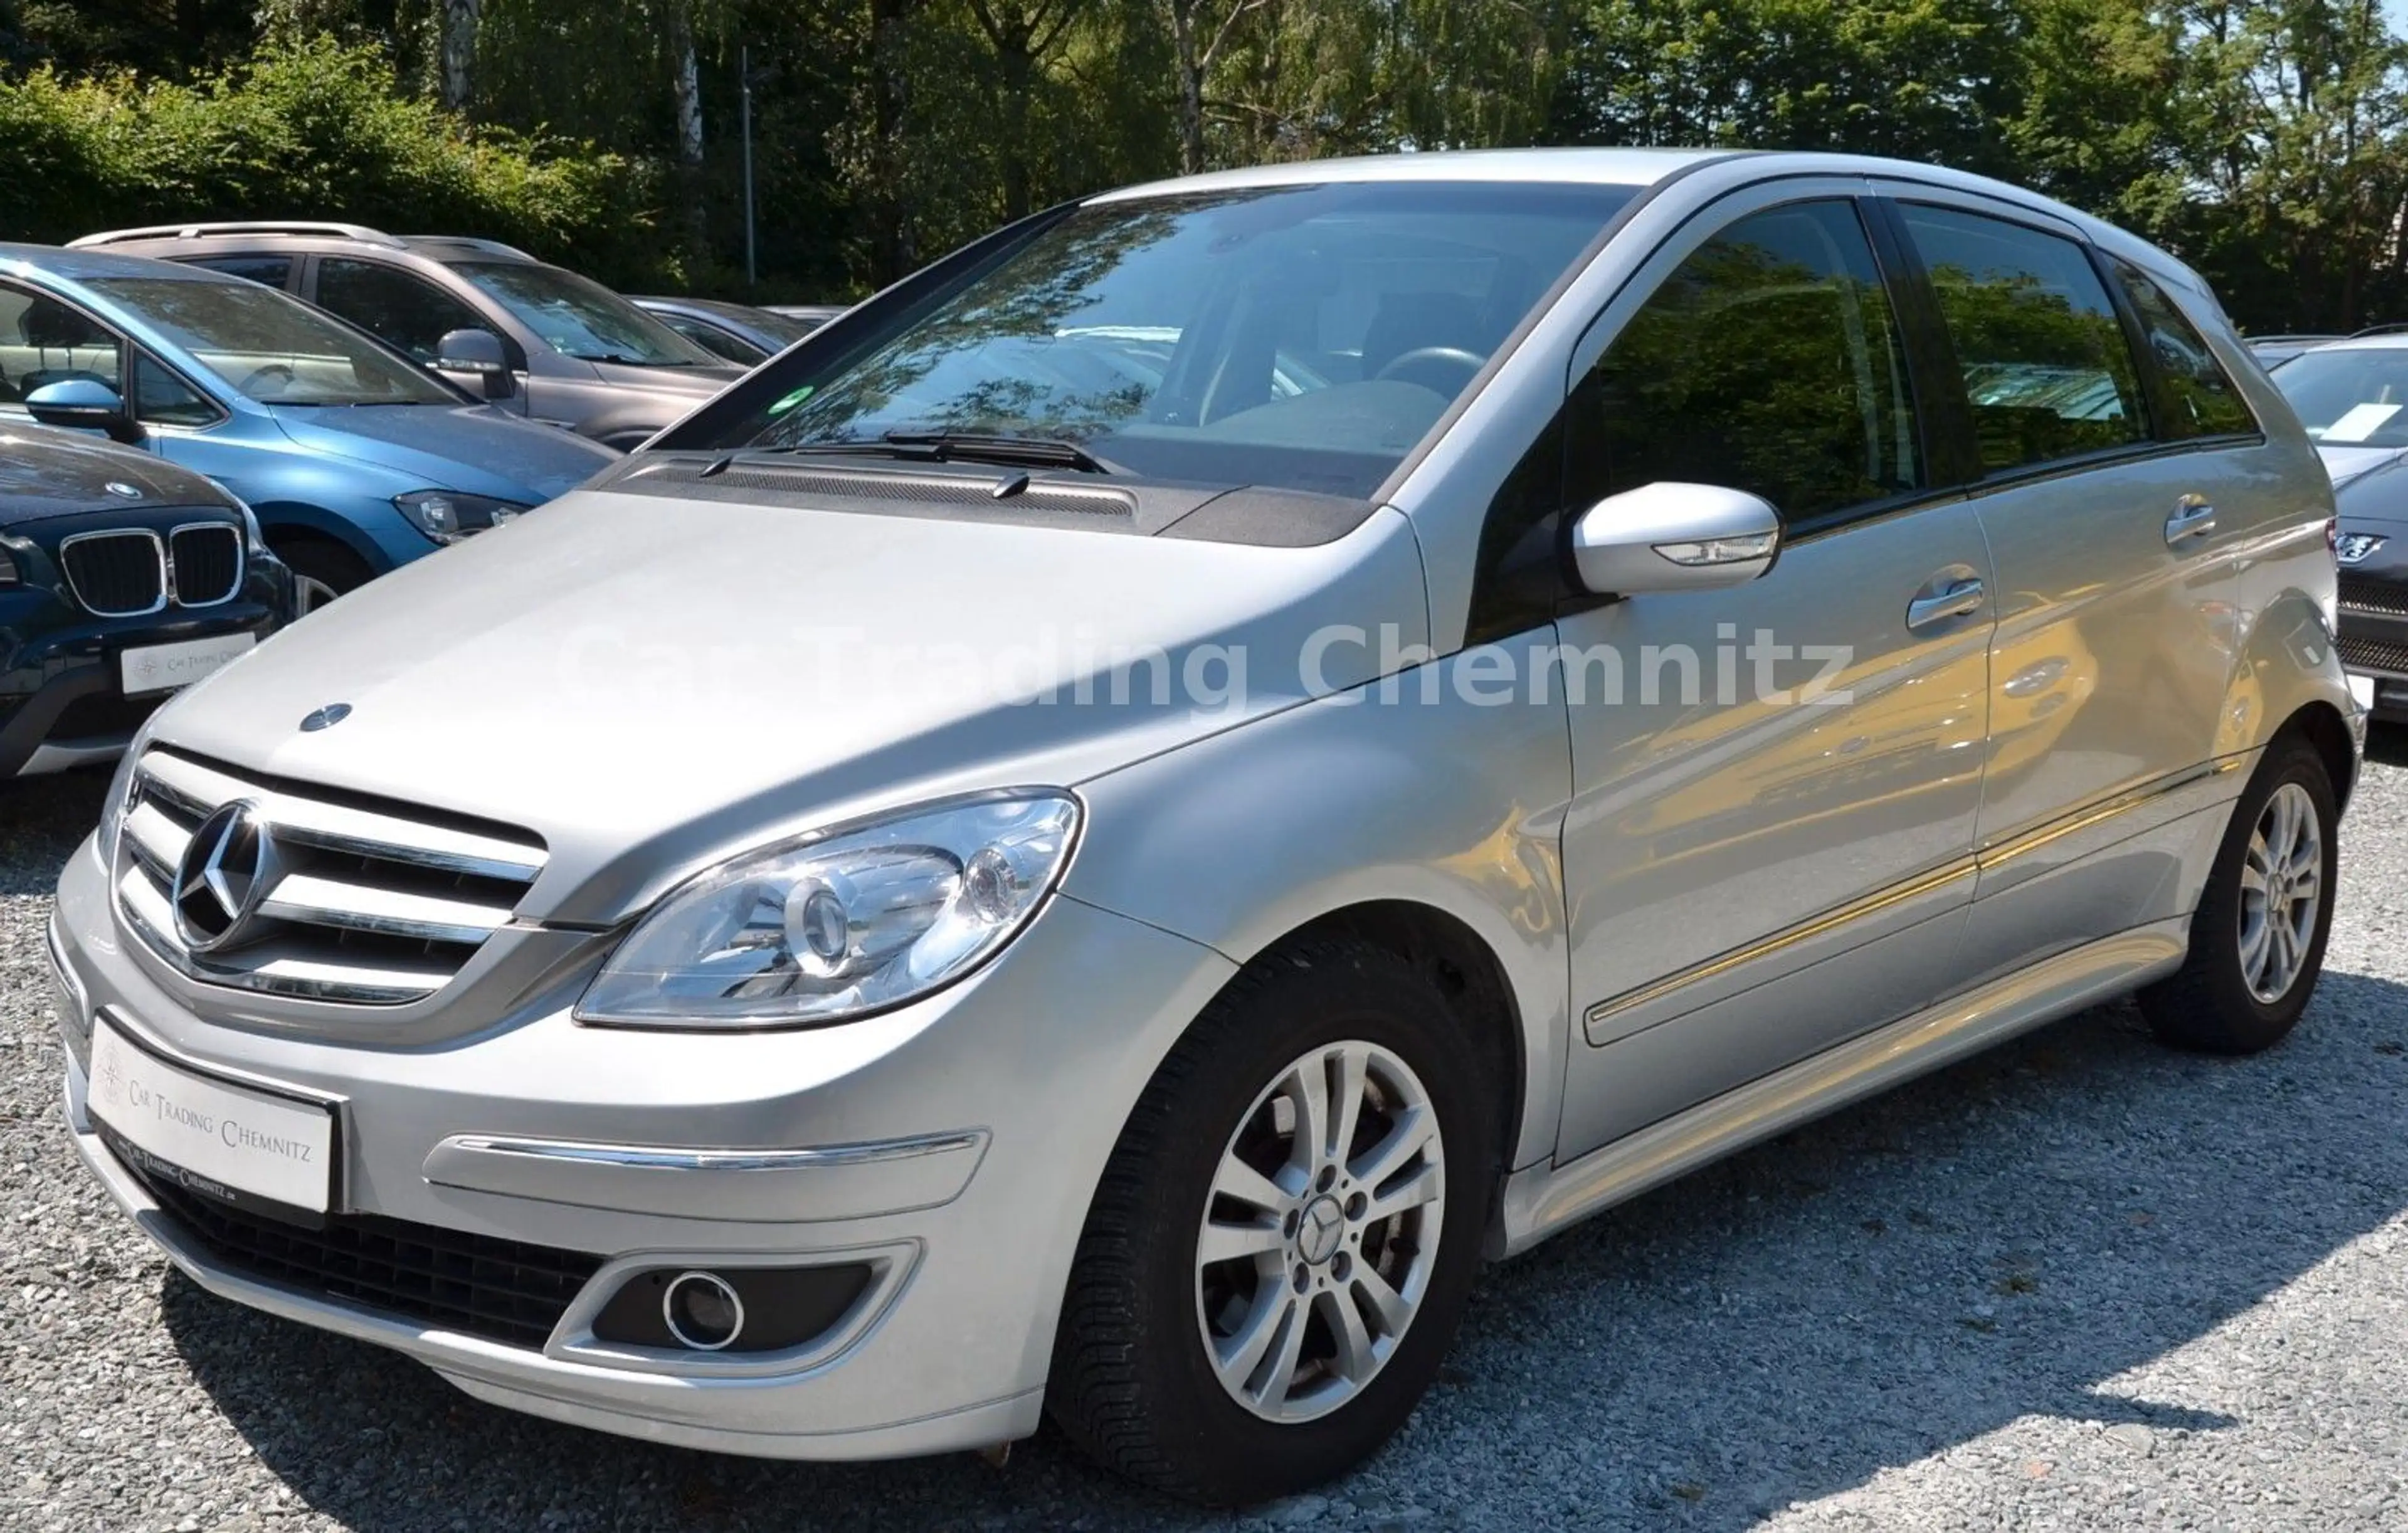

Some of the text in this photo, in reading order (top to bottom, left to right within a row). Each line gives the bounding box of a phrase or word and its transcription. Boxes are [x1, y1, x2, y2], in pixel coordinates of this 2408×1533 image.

[129, 1080, 312, 1162] CAR TRADING CHEMNITZ
